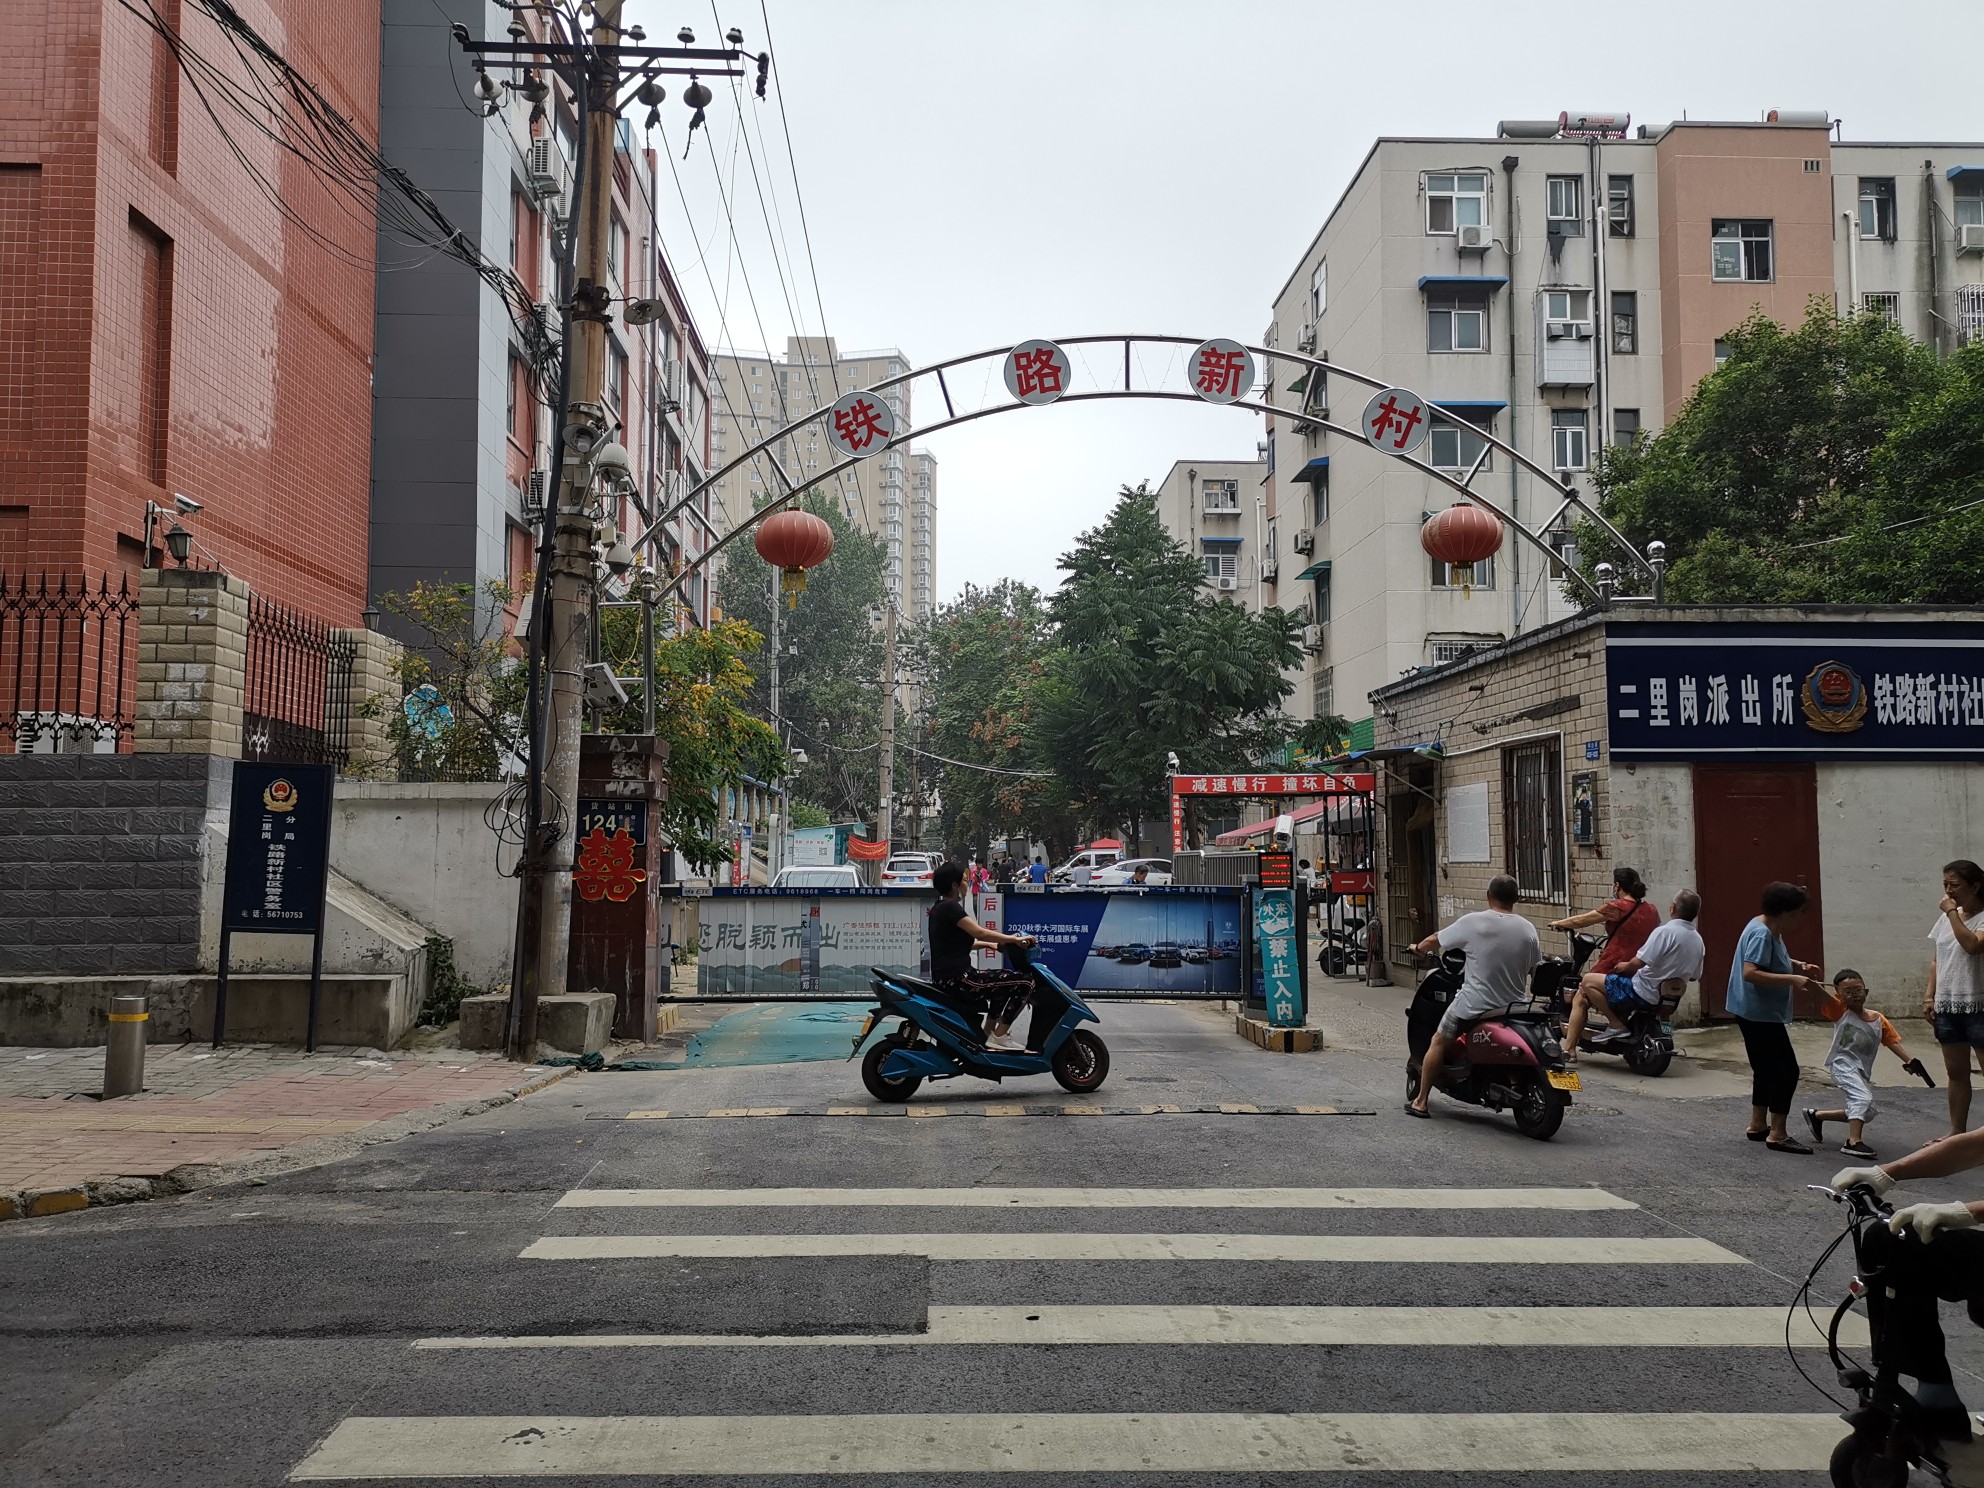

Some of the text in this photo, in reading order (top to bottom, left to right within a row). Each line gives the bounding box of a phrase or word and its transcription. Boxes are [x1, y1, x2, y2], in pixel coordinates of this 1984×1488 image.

[1619, 672, 1984, 727] 二里岗派出所 铁路新村社
[1192, 776, 1357, 792] 减速慢行 撞坏自负
[591, 802, 632, 811] 货站街
[261, 815, 273, 840] 二里岗
[582, 814, 617, 831] 124
[264, 843, 287, 910] 铁路新村社区警务室
[1008, 924, 1089, 934] 2020秋季大河国际车展
[1269, 938, 1293, 1021] 禁止入内
